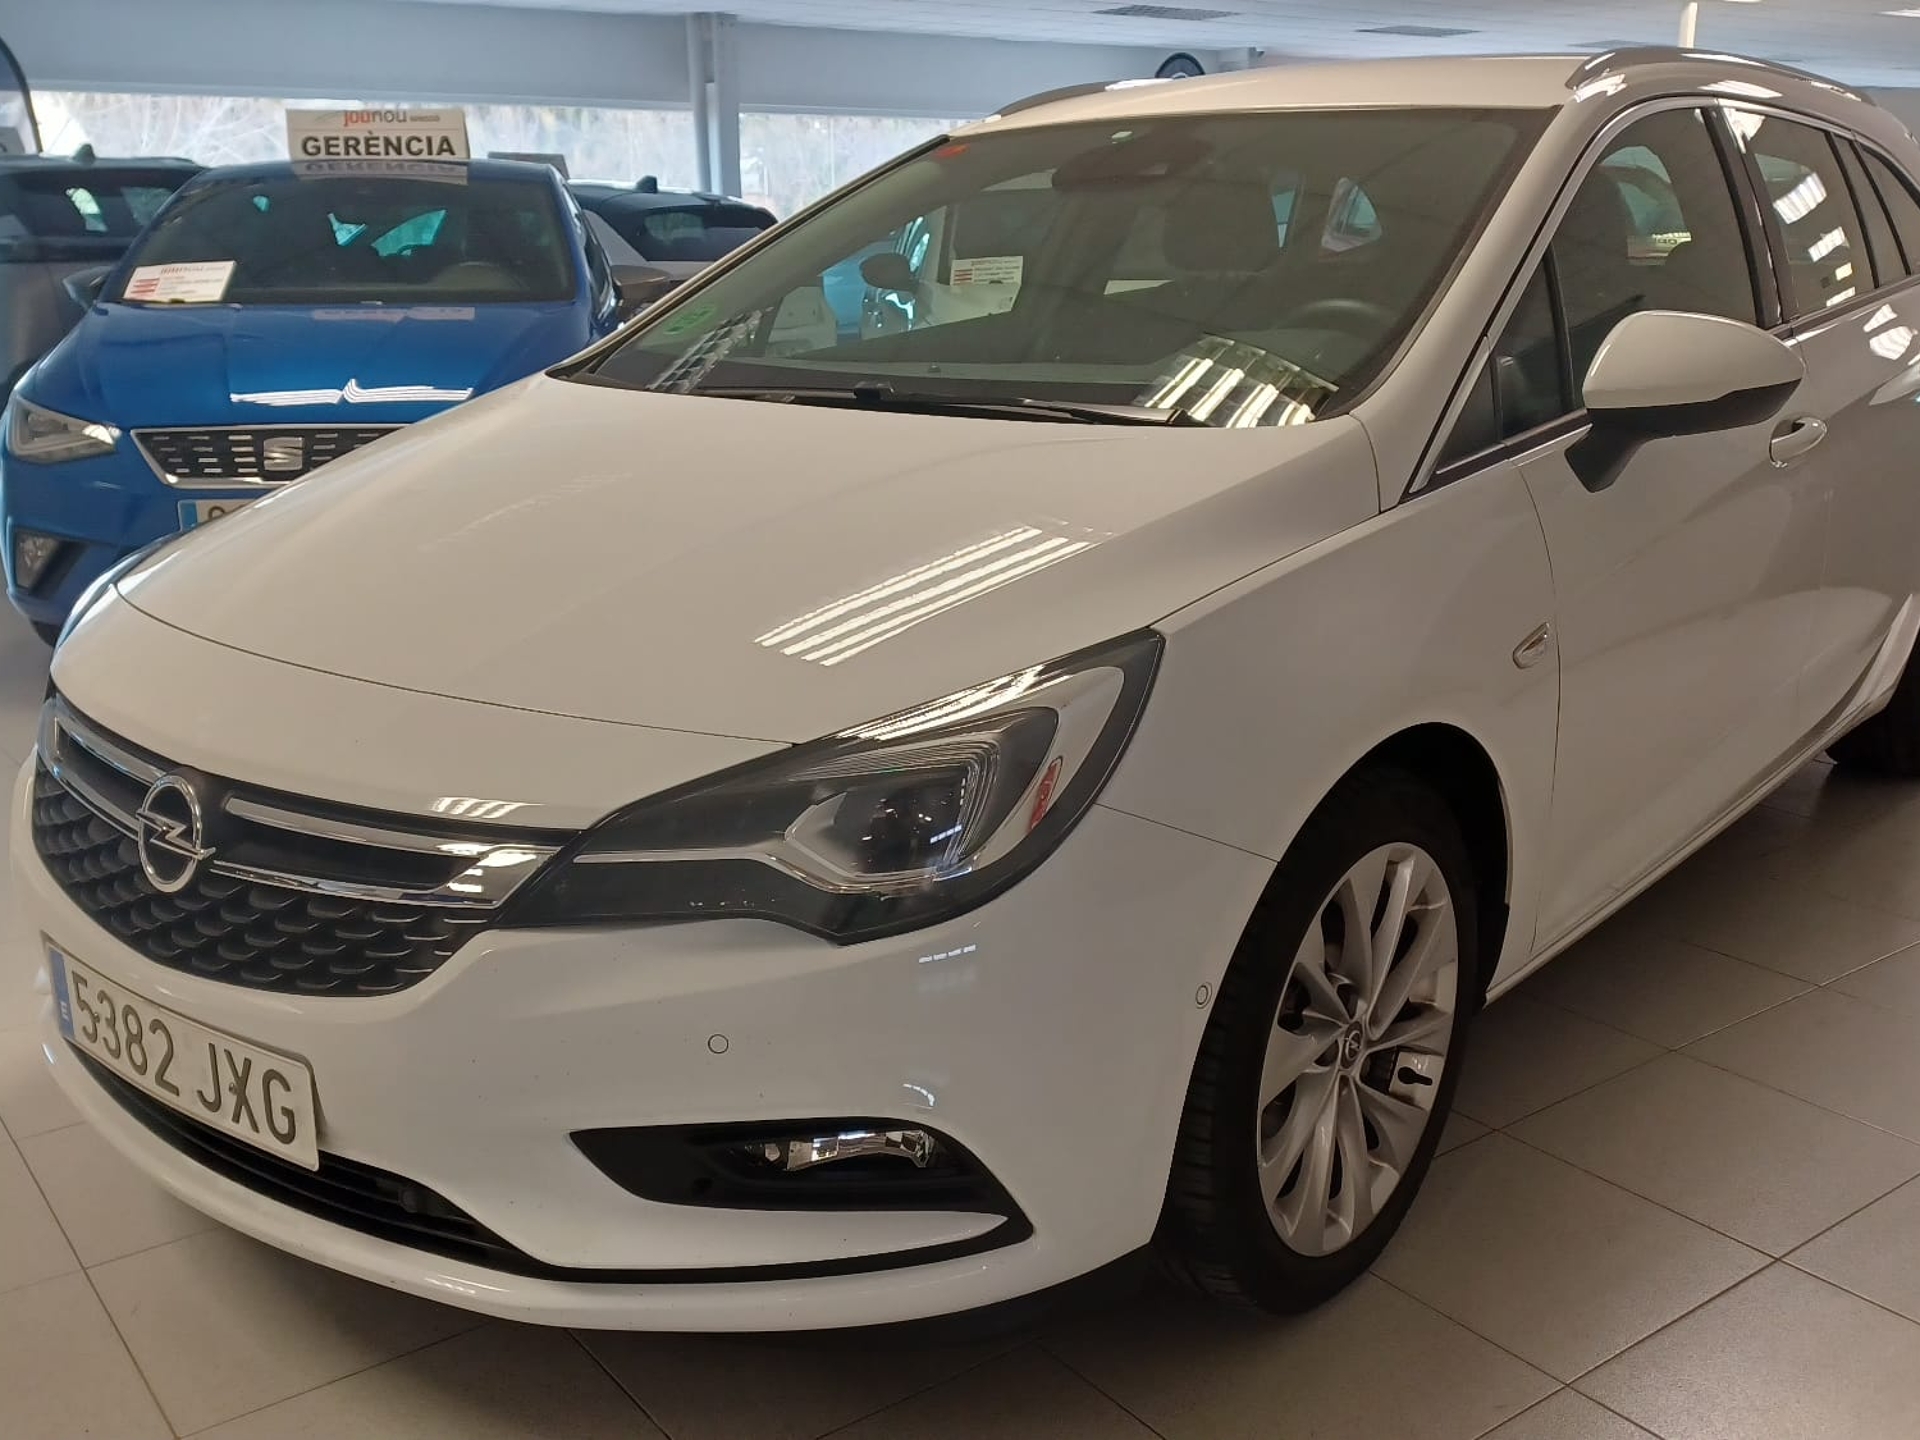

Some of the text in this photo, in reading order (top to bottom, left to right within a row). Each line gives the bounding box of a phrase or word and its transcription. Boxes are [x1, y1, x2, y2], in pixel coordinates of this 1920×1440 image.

[302, 130, 456, 157] GERÈNCIA
[71, 969, 297, 1145] 5382 JXG
